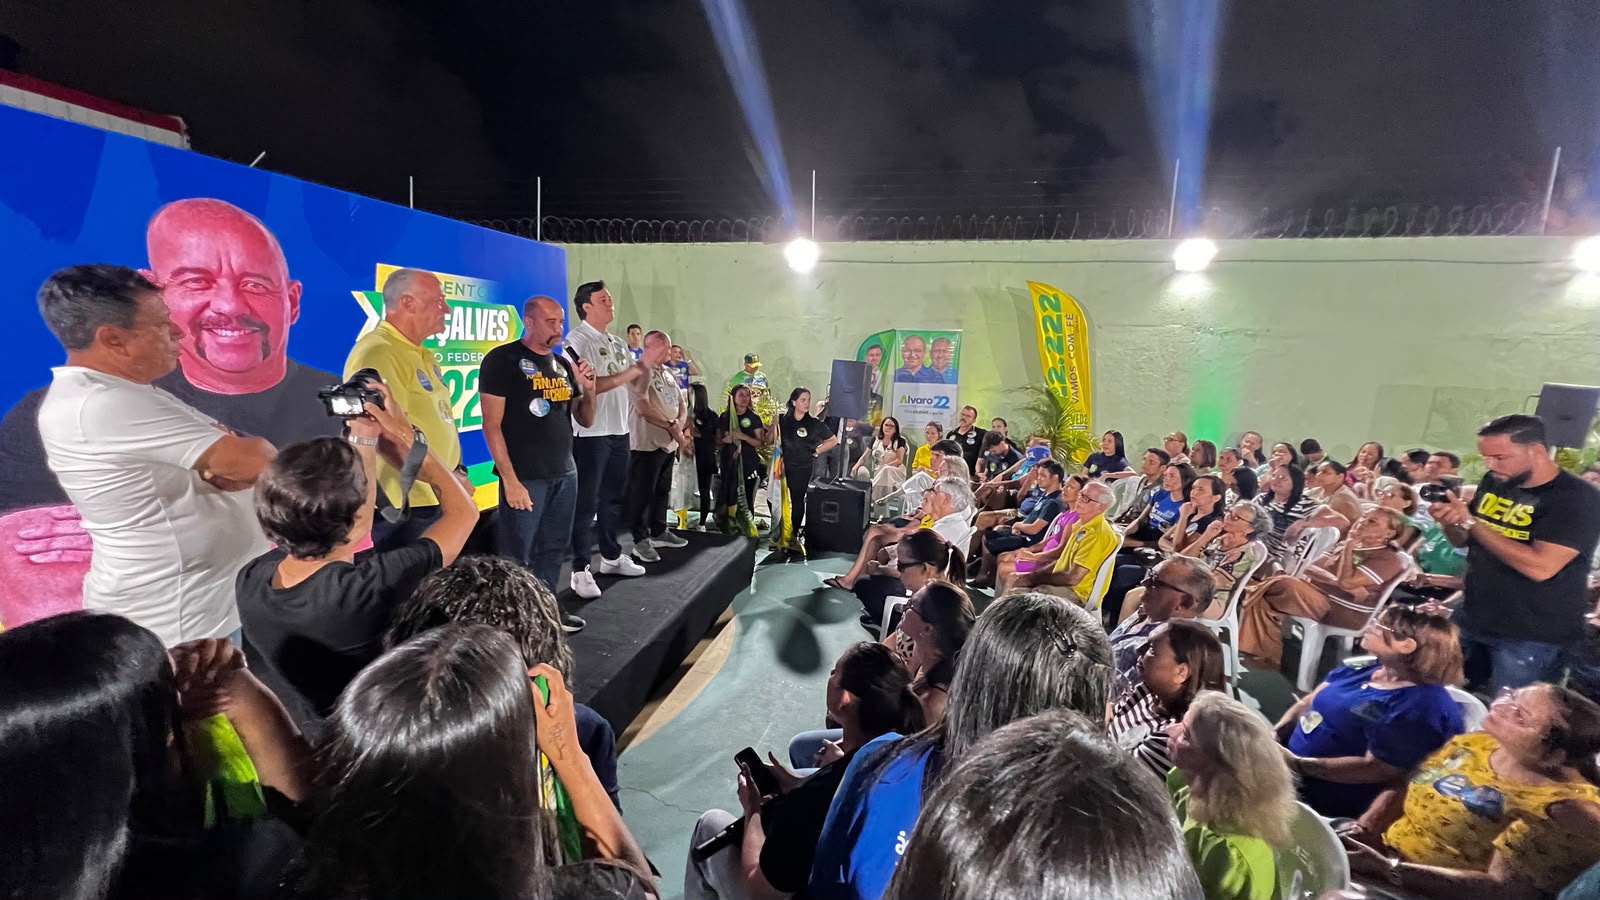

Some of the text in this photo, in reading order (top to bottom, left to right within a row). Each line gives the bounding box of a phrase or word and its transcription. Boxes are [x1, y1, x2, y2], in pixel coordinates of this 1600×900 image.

[443, 281, 488, 298] ENTO
[427, 305, 510, 347] ÇALVES
[1067, 333, 1075, 359] COM
[447, 352, 485, 362] FEDER
[1069, 365, 1079, 404] VAMOS
[900, 395, 950, 409] Alvaro 22
